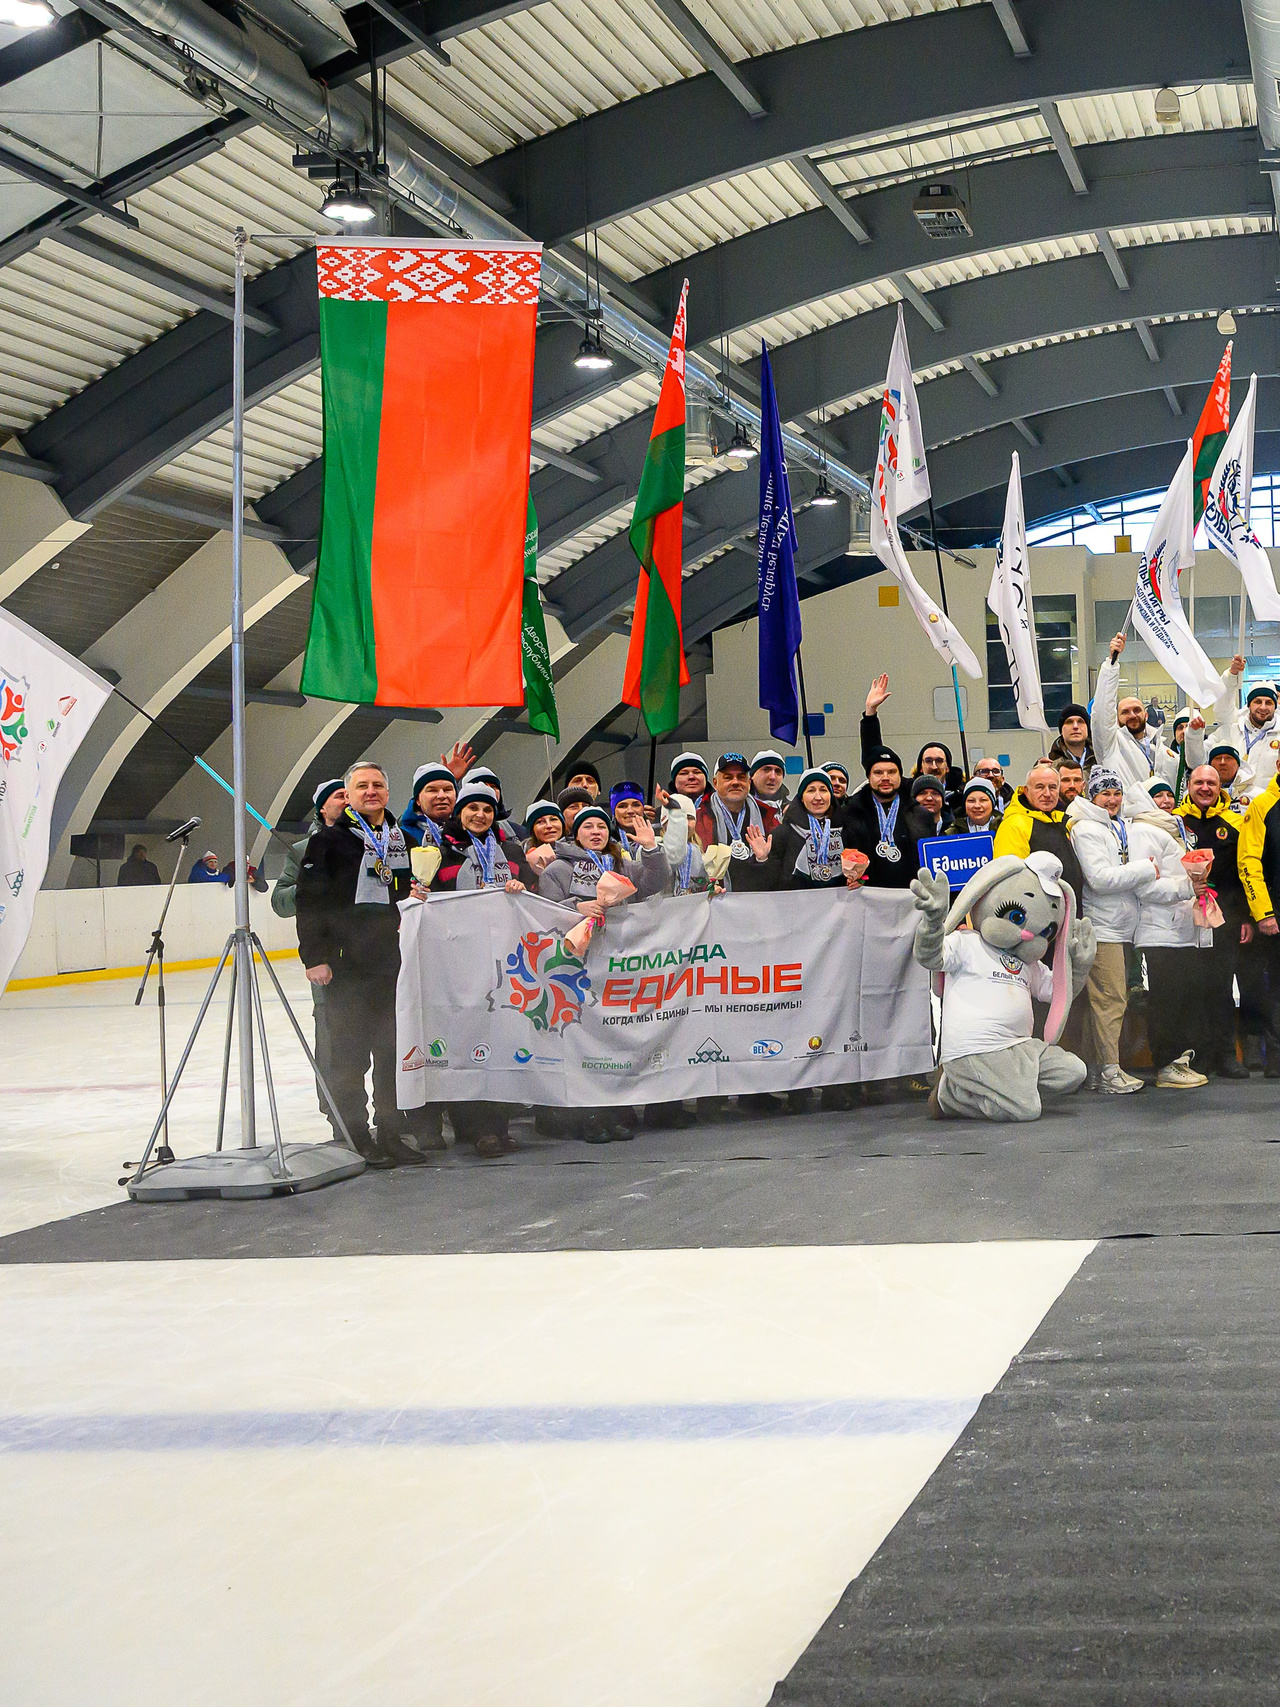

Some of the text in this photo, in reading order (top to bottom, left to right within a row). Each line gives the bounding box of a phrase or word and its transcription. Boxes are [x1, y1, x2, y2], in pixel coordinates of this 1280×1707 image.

[1147, 588, 1171, 626] ТИГРЫ
[932, 855, 988, 873] Единые
[1243, 867, 1257, 901] BELARUS
[608, 943, 727, 973] КОМАНДА
[602, 963, 803, 1013] ЕДИНЫЕ
[602, 1016, 634, 1026] КОГДА
[636, 1013, 654, 1024] МЫ
[656, 1007, 690, 1021] ЕДИНЫ
[704, 1004, 723, 1014] МЫ
[726, 1000, 803, 1013] НЕПОБЕДИМЫ!
[581, 1060, 632, 1070] ВОСТОЧНЫЙ
